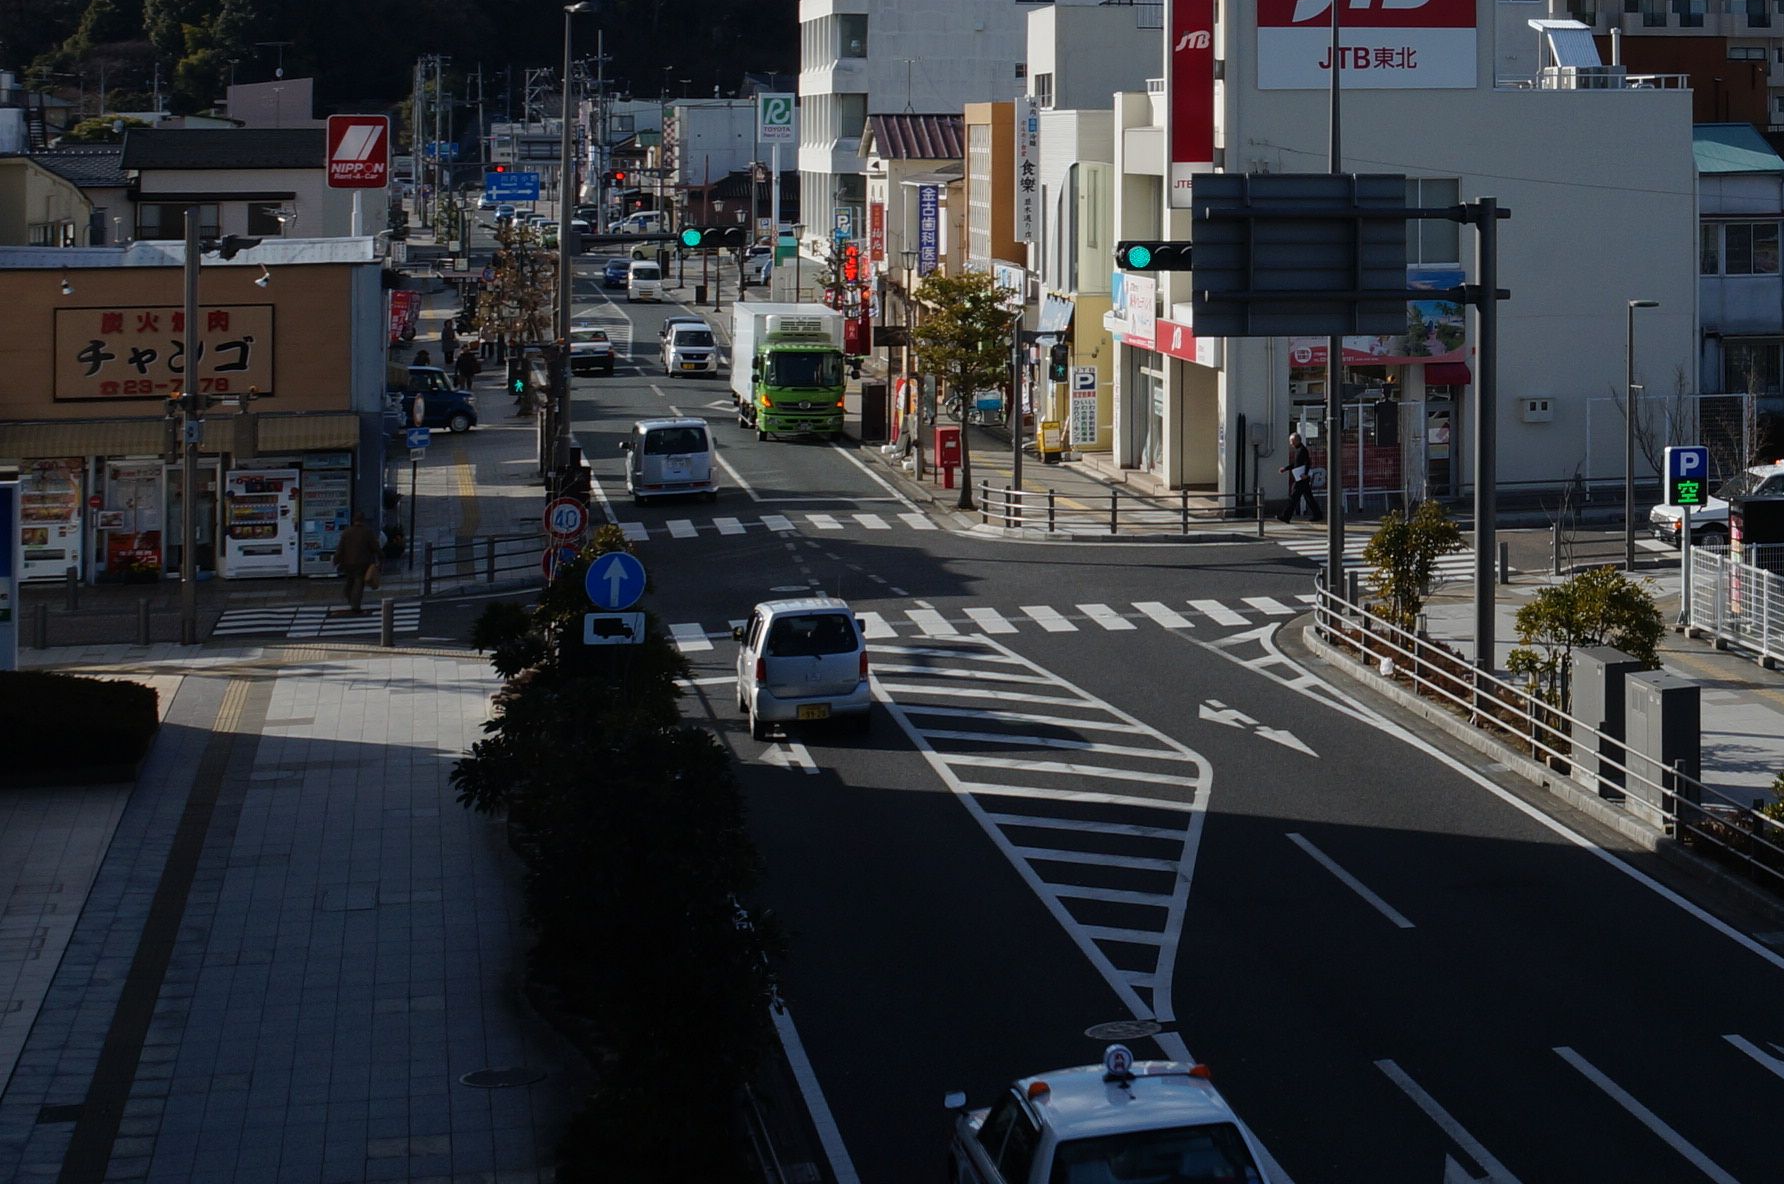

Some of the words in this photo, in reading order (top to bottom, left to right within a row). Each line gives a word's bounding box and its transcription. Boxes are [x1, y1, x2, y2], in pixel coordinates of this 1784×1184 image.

[1176, 30, 1211, 52] JTB
[331, 163, 385, 173] NIPPON
[920, 187, 938, 278] 金古歯科医院
[123, 378, 229, 394] 23-778
[1075, 374, 1094, 389] P
[1680, 452, 1700, 477] P
[1677, 480, 1699, 503] 空
[556, 510, 577, 529] 40
